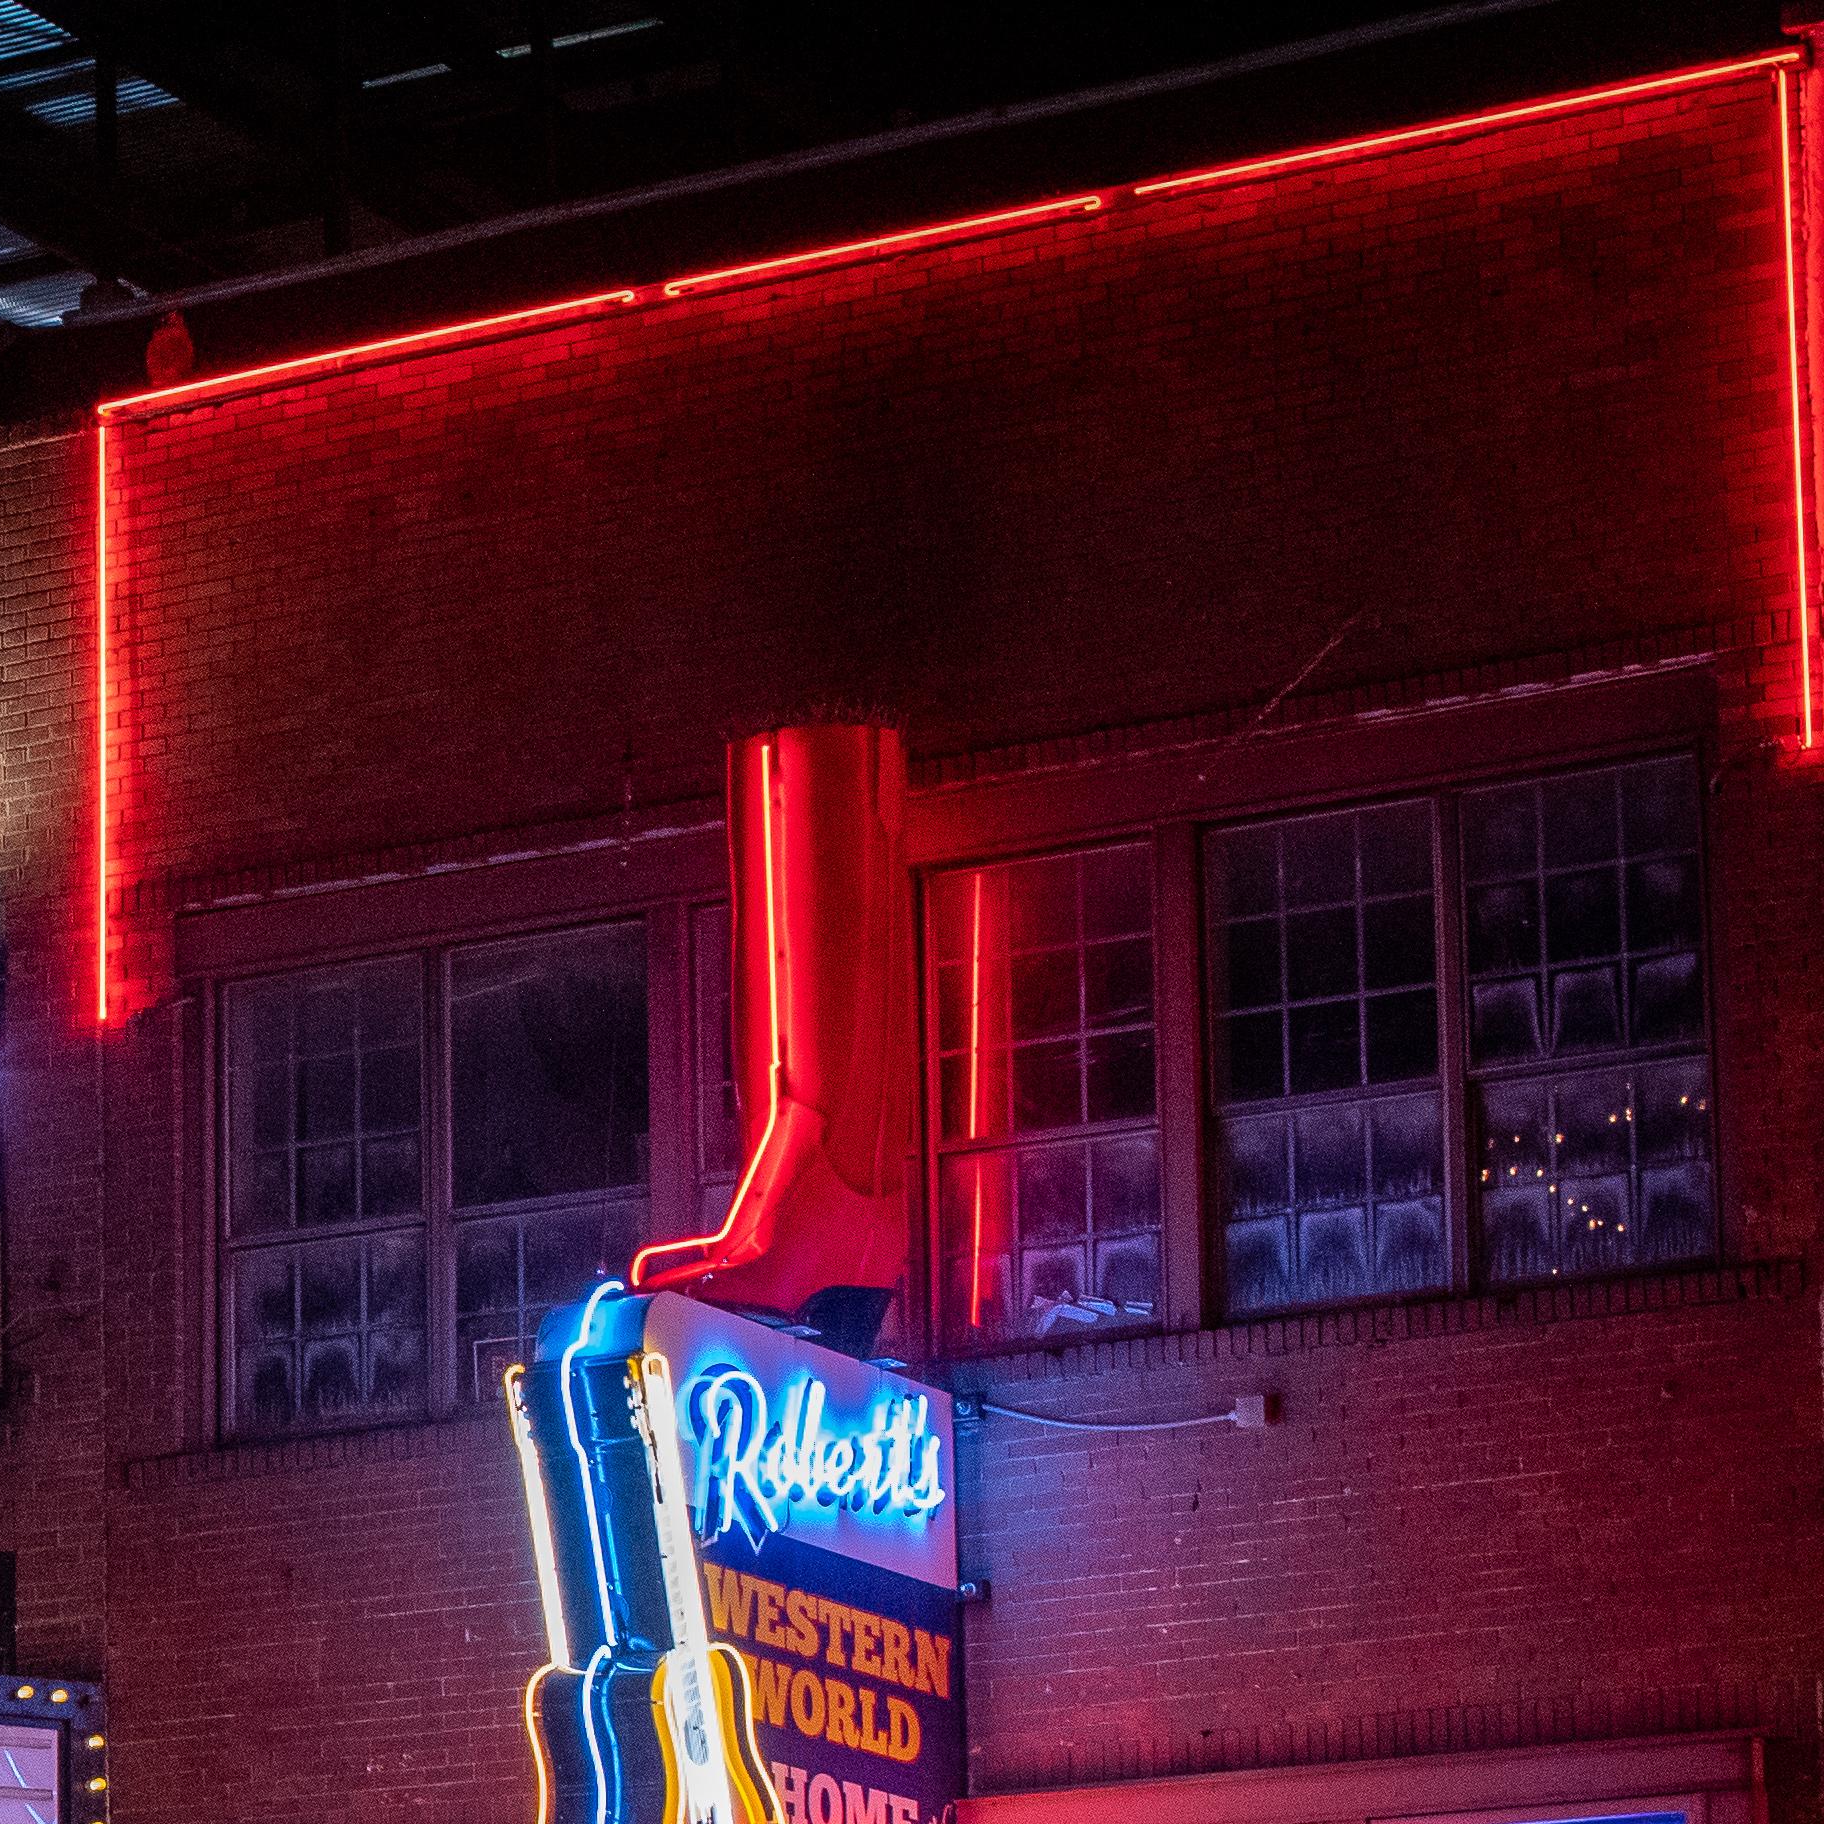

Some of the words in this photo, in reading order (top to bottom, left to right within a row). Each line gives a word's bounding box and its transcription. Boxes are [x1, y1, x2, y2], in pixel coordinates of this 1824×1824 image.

[689, 1370, 945, 1534] Robert's
[703, 1563, 951, 1699] WESTERN
[740, 1653, 921, 1763] WORLD
